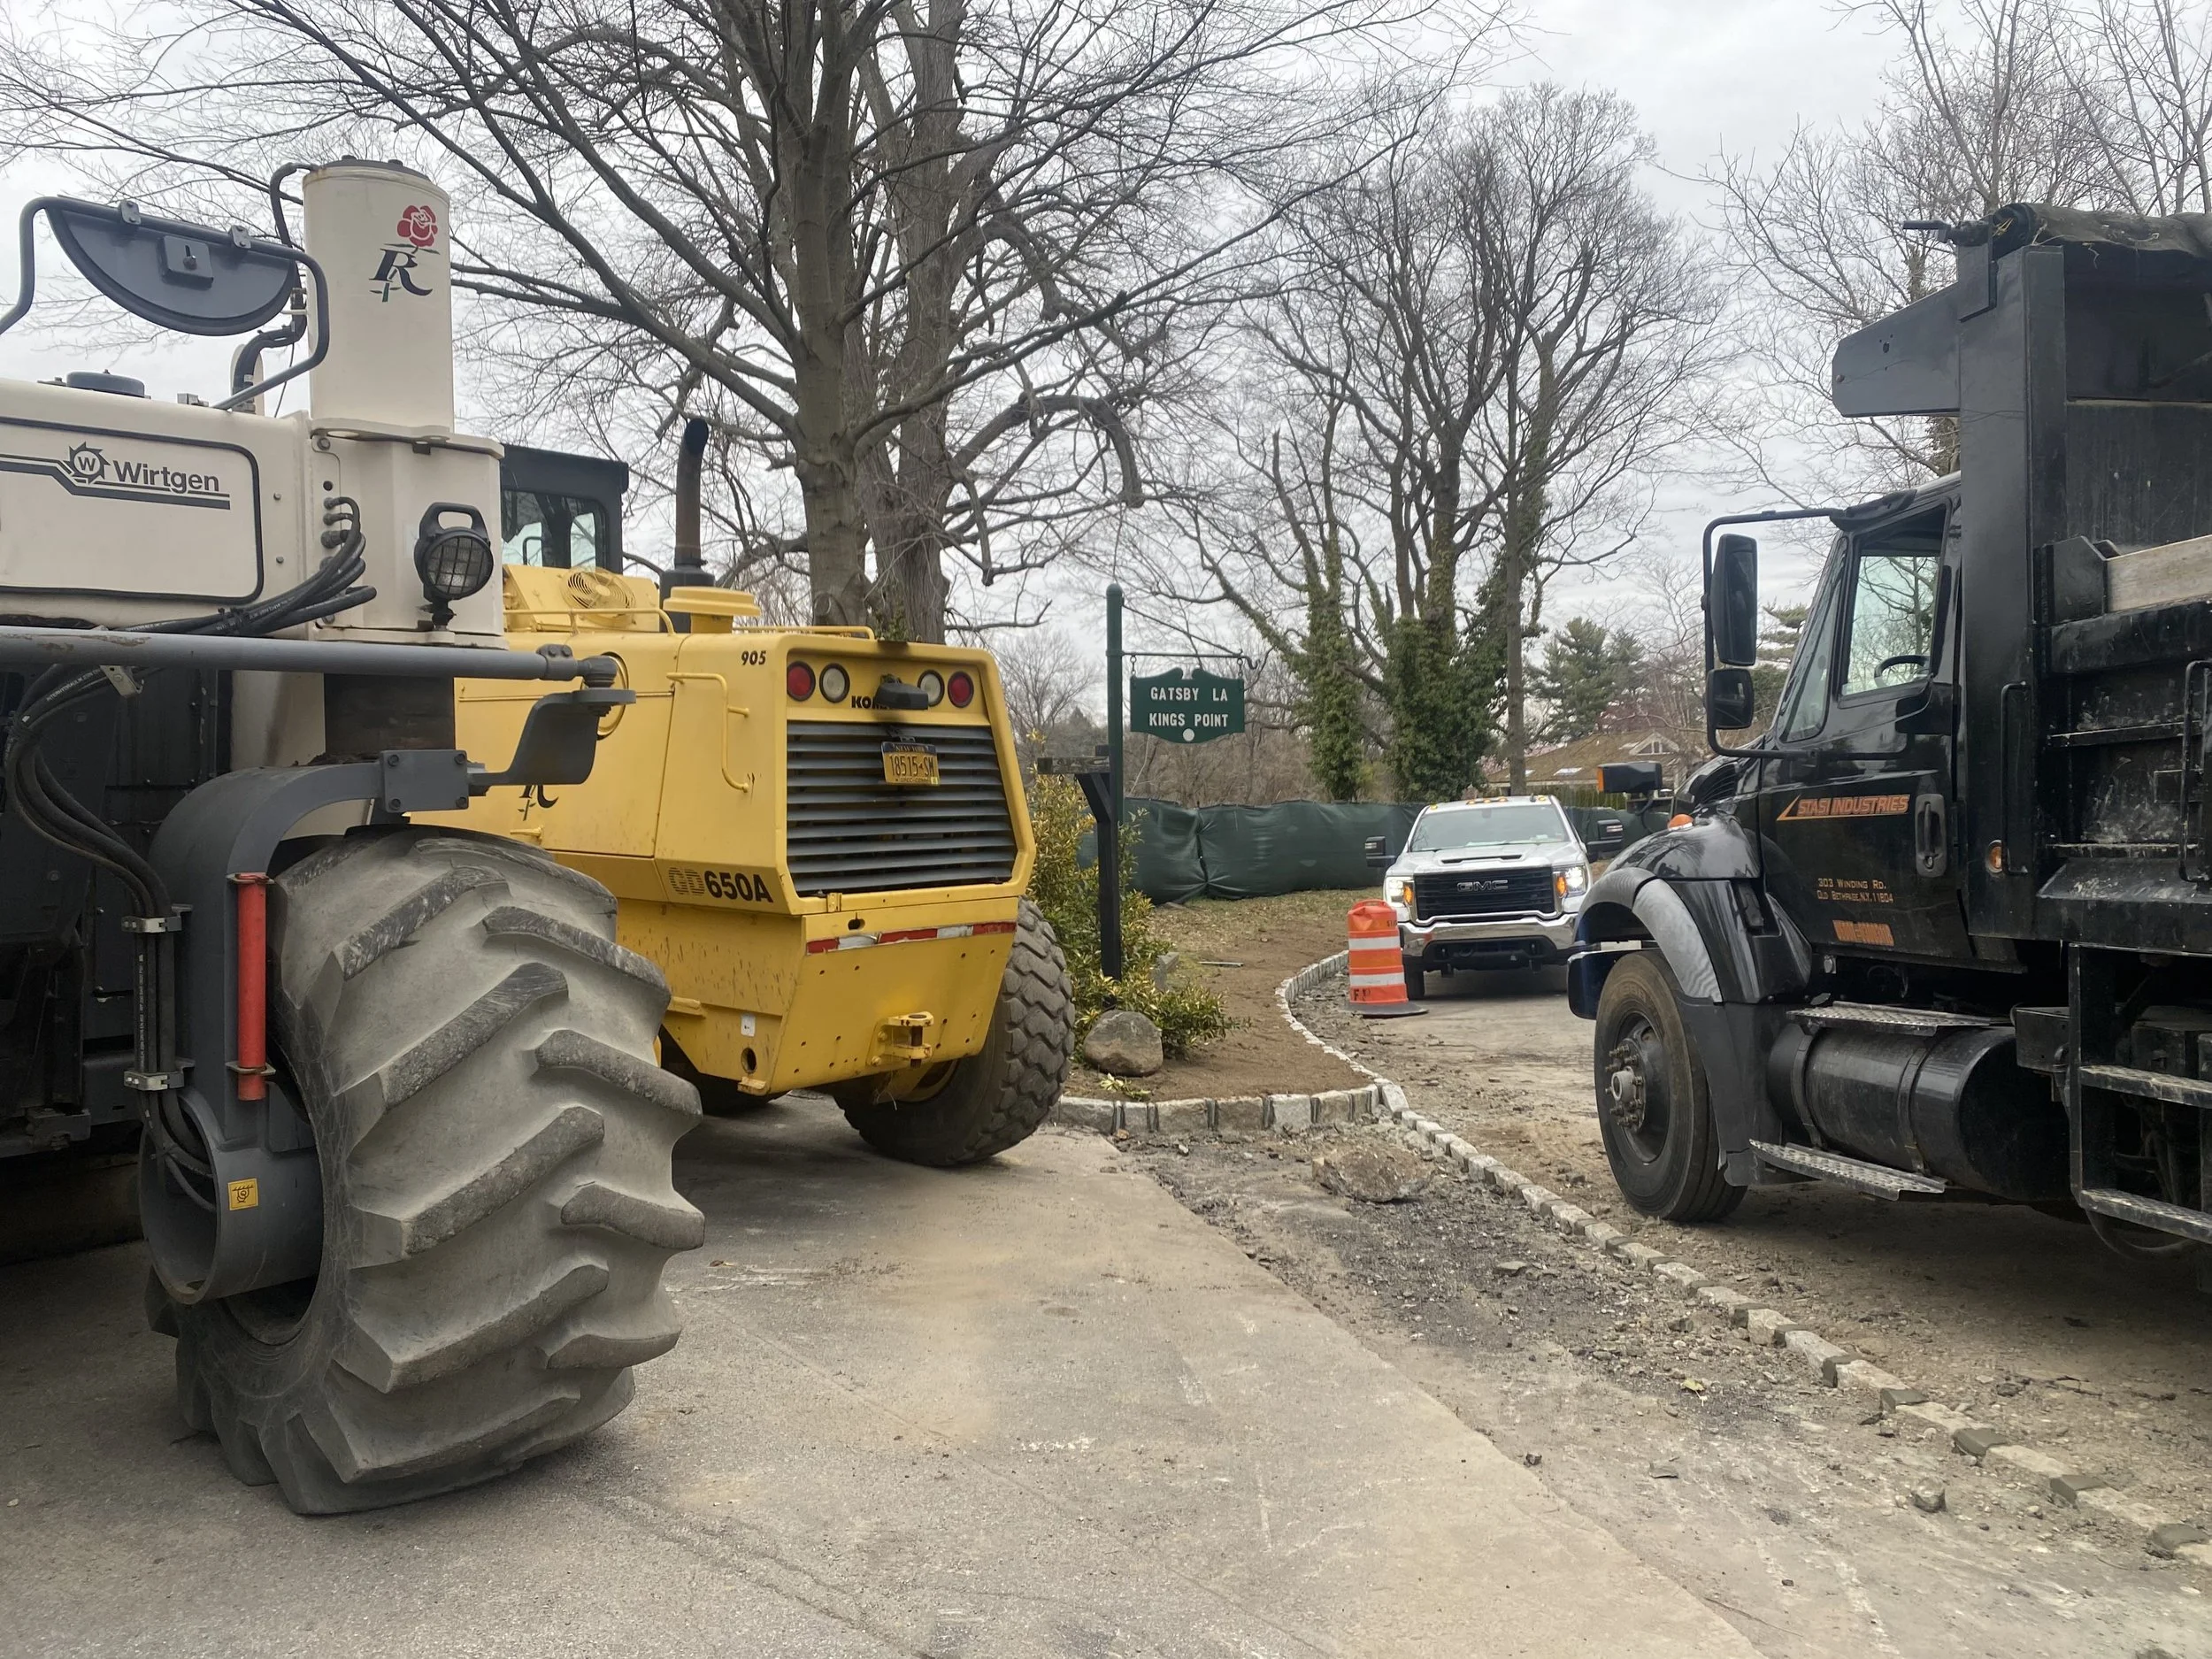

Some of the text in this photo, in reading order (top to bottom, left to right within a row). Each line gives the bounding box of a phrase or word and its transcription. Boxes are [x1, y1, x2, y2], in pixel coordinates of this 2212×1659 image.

[77, 456, 96, 472] W
[112, 459, 219, 495] Wirtgen
[741, 650, 767, 665] 905
[1150, 687, 1228, 702] GATSBY LA
[1149, 712, 1228, 727] KINGS POINT
[1796, 795, 1911, 817] STASI INDUSTRIES
[1457, 879, 1509, 892] GMC
[1817, 878, 1834, 887] 303
